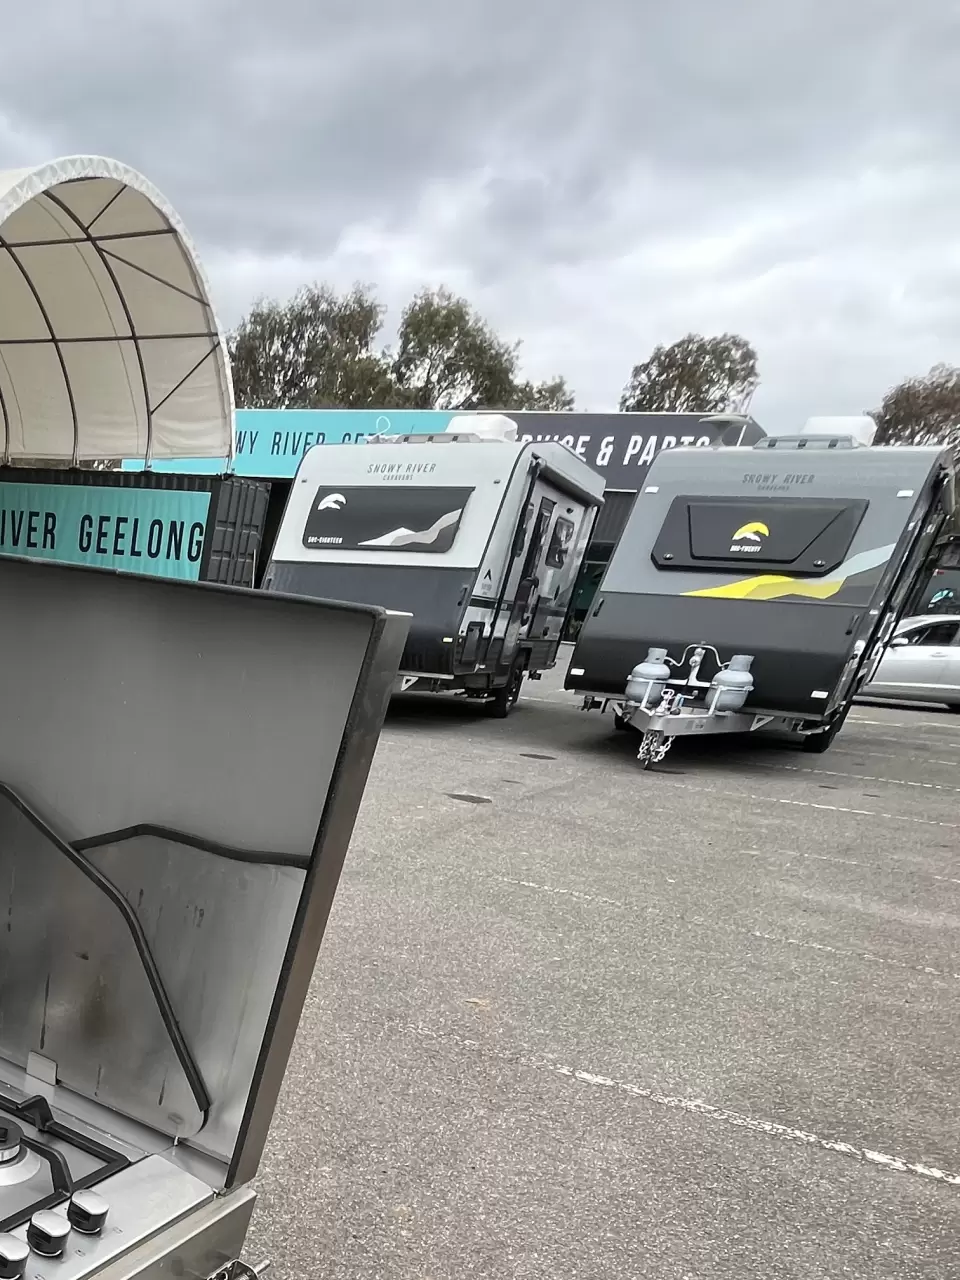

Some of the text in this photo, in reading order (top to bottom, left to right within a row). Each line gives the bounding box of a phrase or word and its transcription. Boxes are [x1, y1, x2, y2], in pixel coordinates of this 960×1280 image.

[367, 463, 437, 474] SNOWY RIVER
[742, 473, 815, 484] SNOWY RIVER
[79, 514, 204, 563] GEELONG
